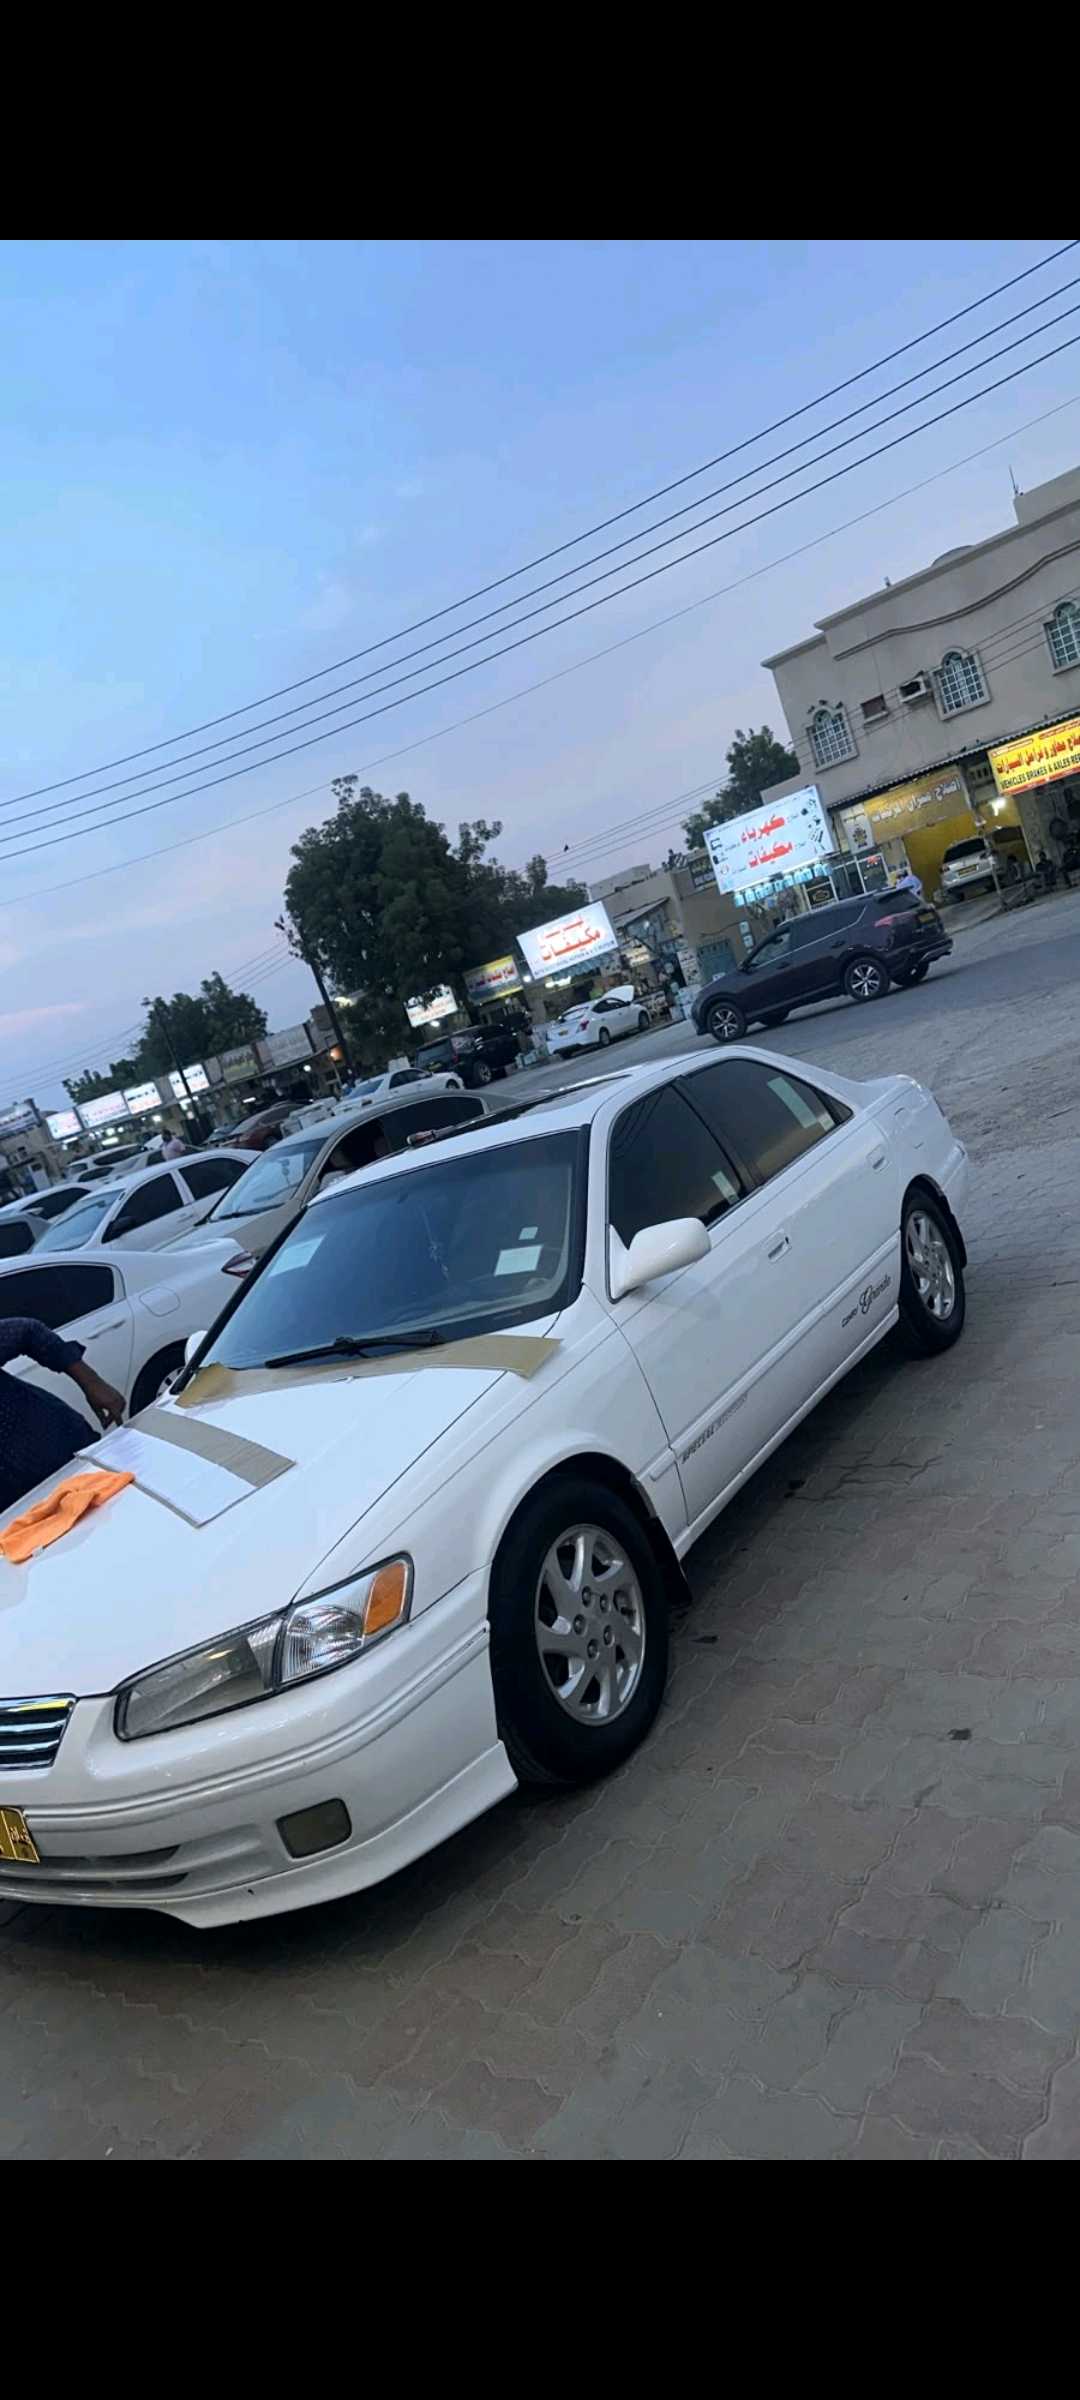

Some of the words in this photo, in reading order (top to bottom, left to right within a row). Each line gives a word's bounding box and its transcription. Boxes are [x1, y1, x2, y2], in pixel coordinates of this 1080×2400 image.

[1001, 773, 1027, 790] VEHICLES
[1026, 766, 1047, 780] BRAKES
[741, 813, 785, 843] كهرباء
[748, 842, 793, 868] مكيفات
[542, 927, 601, 961] مكيفات
